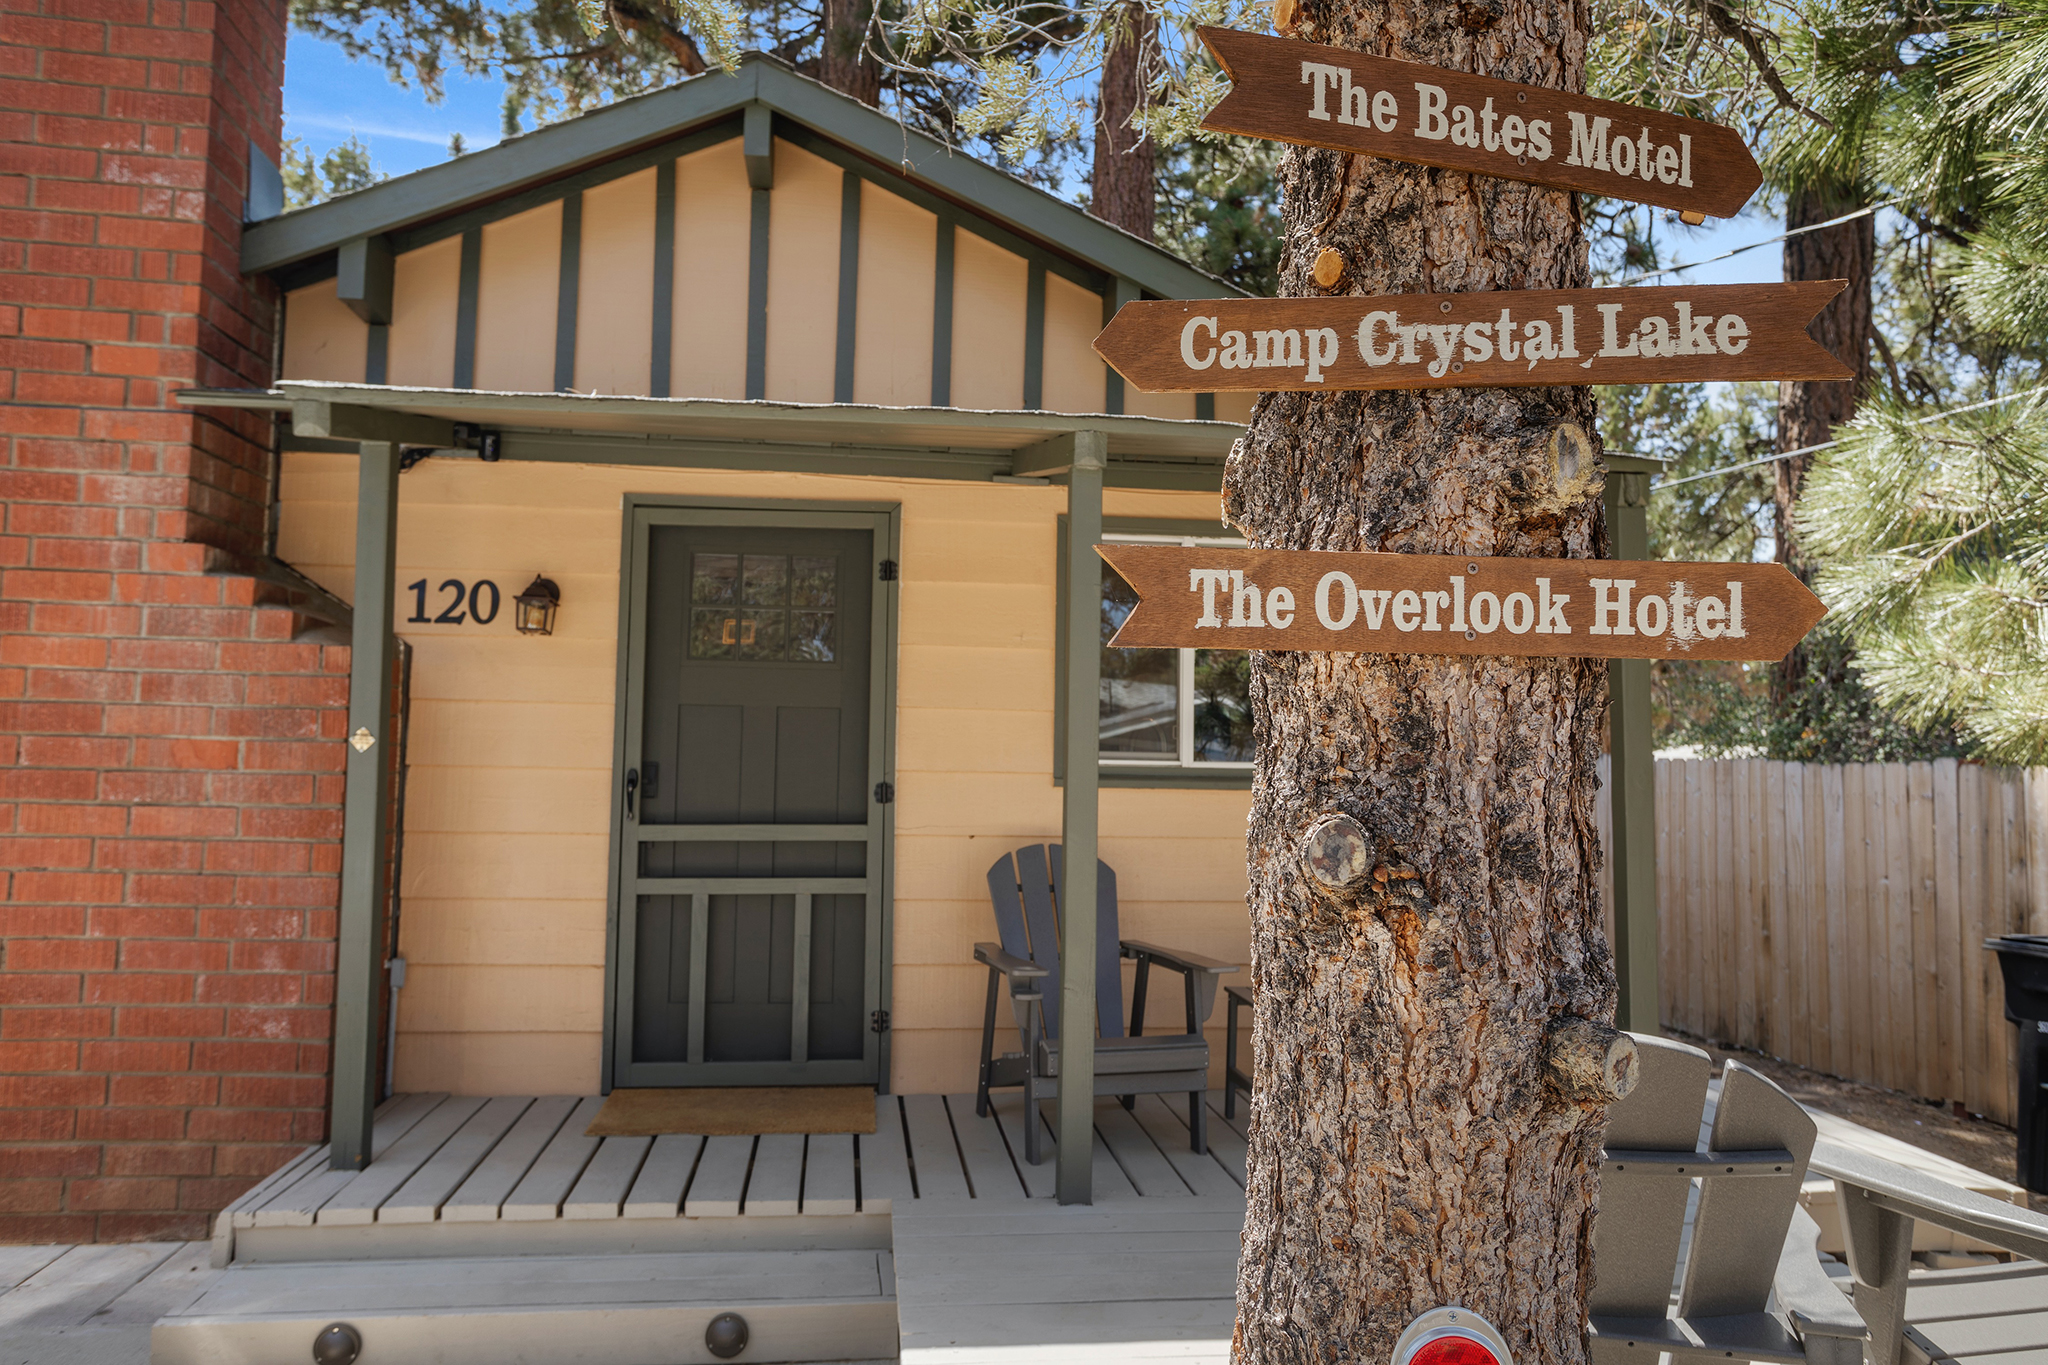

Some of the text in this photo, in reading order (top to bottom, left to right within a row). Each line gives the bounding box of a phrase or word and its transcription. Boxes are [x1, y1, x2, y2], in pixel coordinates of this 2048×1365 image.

[1301, 61, 1694, 188] The Bates Motel
[1180, 301, 1750, 384] Camp Crystal Lake
[407, 578, 501, 625] 120
[1189, 568, 1747, 642] The Overlook Hotel
